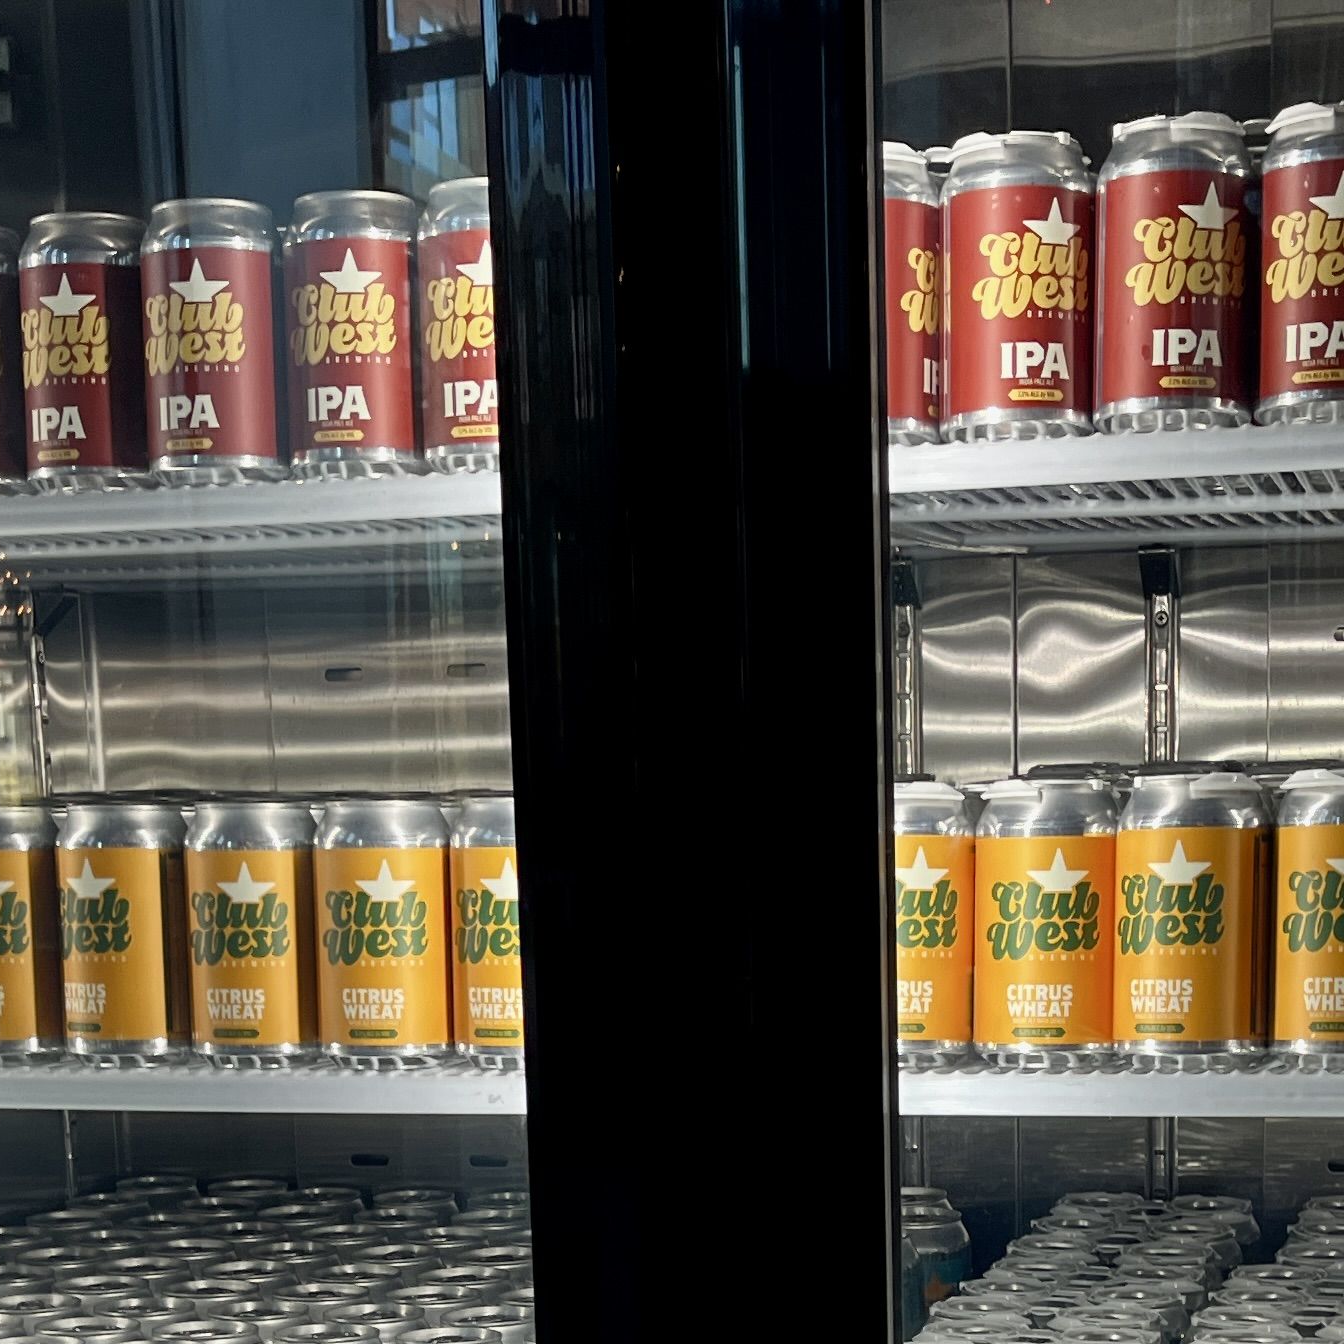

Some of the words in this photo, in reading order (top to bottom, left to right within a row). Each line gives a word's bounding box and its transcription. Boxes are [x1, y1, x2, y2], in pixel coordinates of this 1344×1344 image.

[146, 292, 244, 335] Club
[294, 283, 394, 323] Club
[146, 330, 245, 376] West
[293, 319, 397, 366] West
[1000, 342, 1070, 380] IPA
[1151, 328, 1224, 367] IPA
[160, 394, 220, 432] IPA
[308, 386, 371, 422] IPA
[325, 890, 428, 928] Club
[992, 880, 1099, 919] Club
[324, 925, 428, 966] West
[987, 916, 1100, 961] West
[343, 987, 405, 1004] CITRUS
[343, 1004, 405, 1019] WHEAT
[1007, 984, 1073, 1001] CITRUS
[1007, 1001, 1072, 1018] WHEAT
